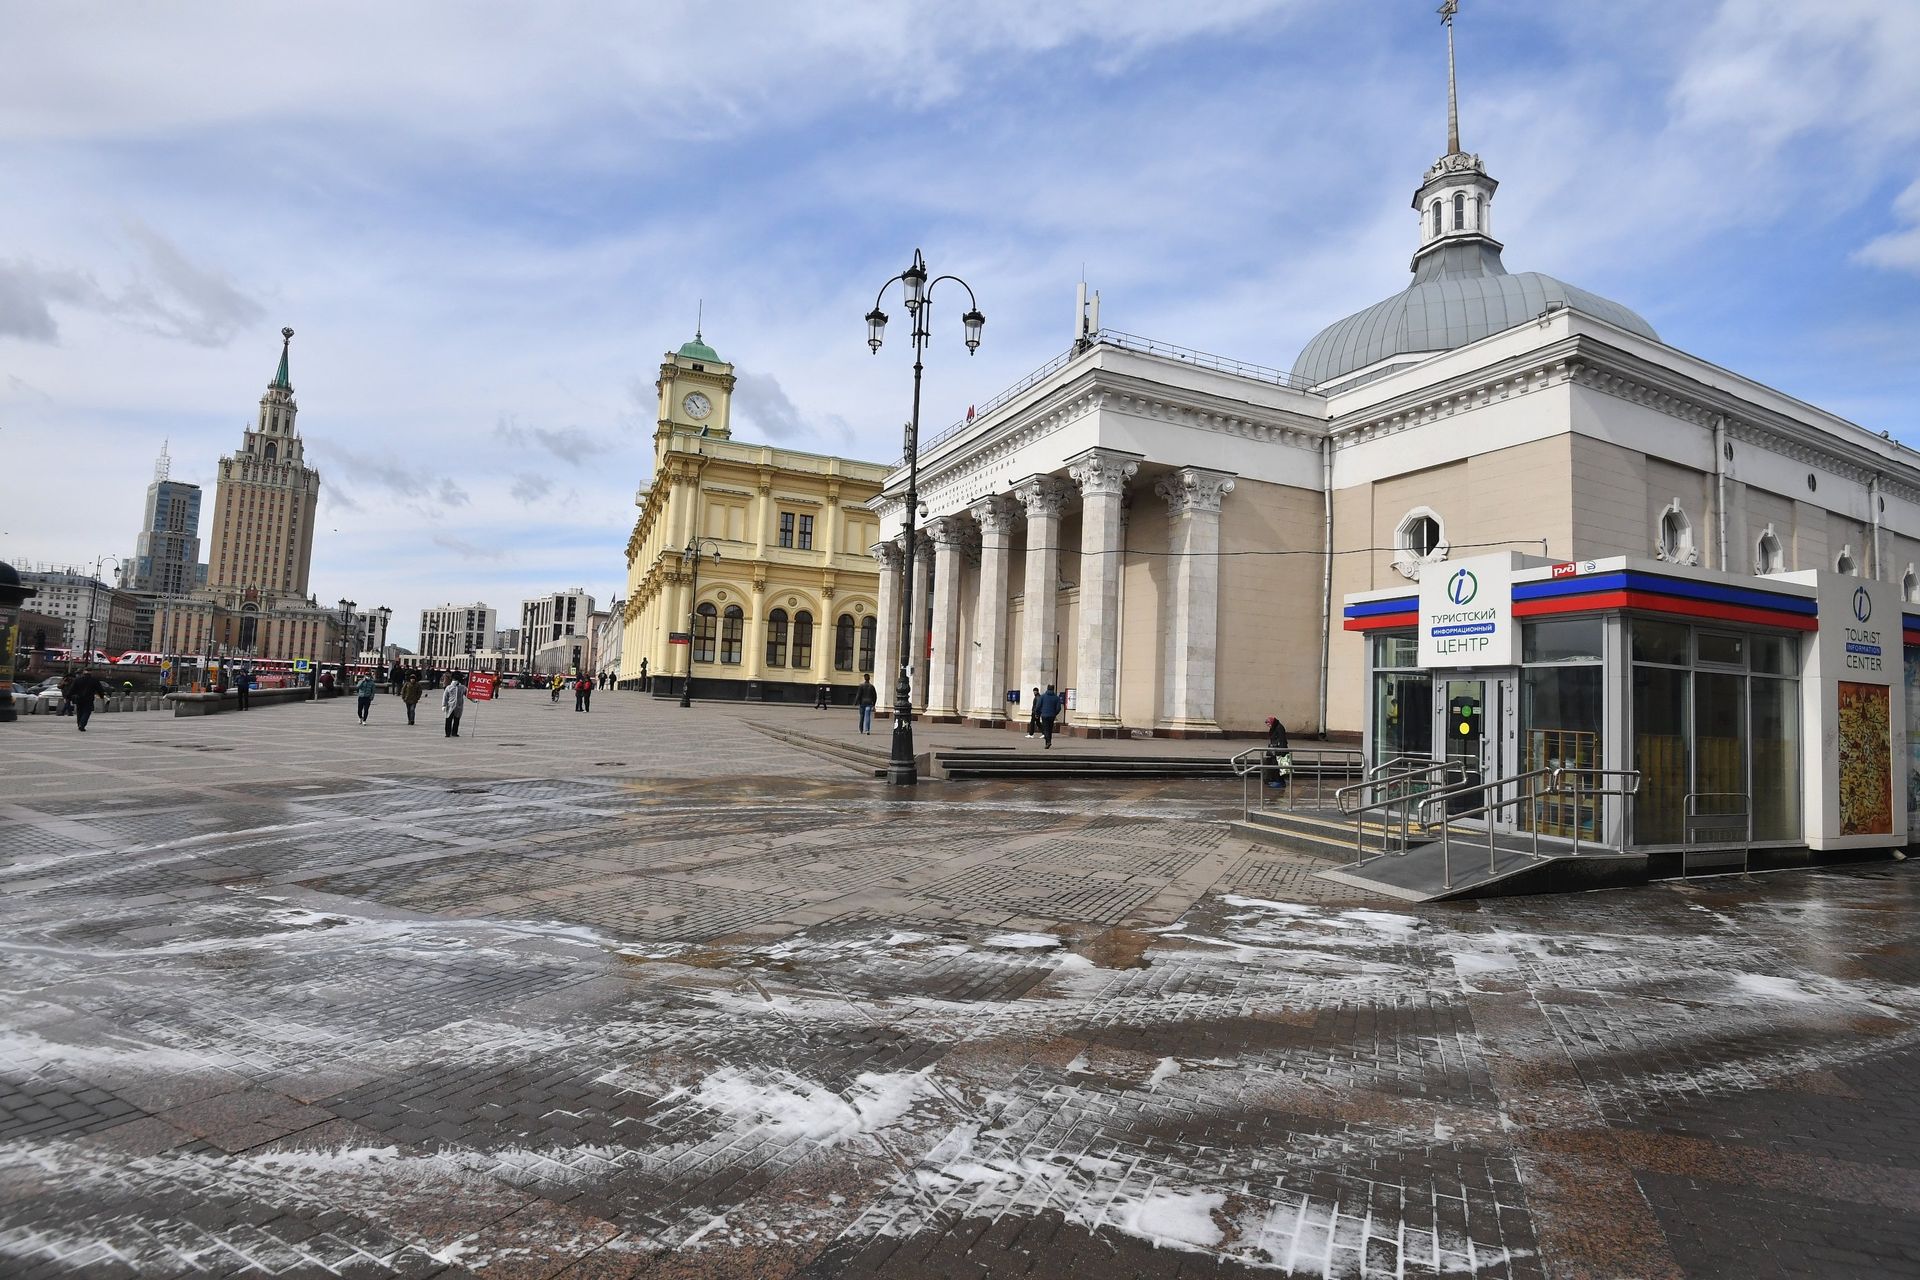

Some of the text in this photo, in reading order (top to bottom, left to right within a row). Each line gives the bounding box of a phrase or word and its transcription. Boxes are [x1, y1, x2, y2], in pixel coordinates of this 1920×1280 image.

[1431, 608, 1496, 624] ТУРИСТСКИЙ
[1433, 624, 1493, 635] ИНФОРМАЦИОННЫЙ
[1845, 628, 1881, 644] TOURIST
[1436, 637, 1489, 655] ЦЕНТР
[1847, 643, 1880, 654] INFORMATION
[1846, 655, 1882, 672] CENTER
[476, 677, 492, 685] KFC
